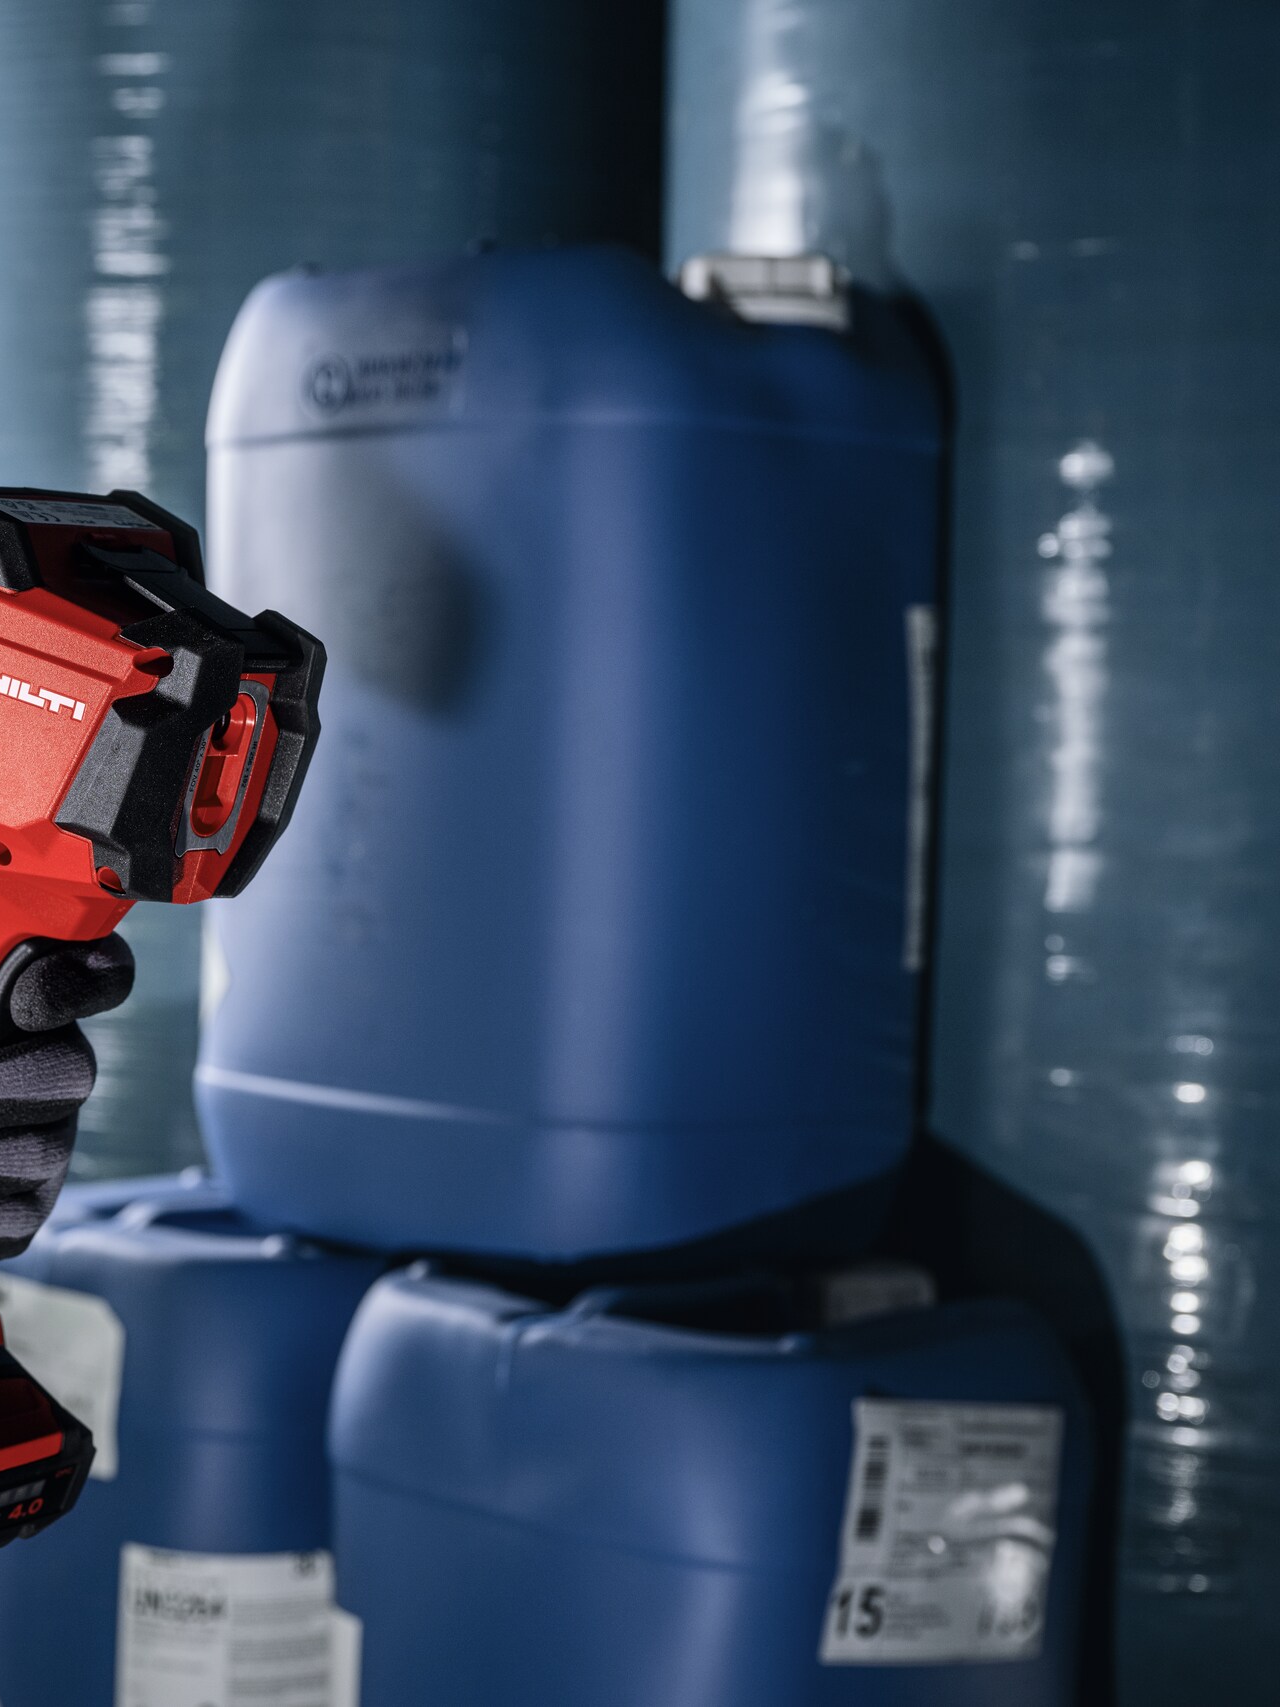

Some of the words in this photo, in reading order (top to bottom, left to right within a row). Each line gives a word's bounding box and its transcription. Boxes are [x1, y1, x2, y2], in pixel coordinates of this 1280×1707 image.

[189, 775, 198, 793] FOV
[7, 1498, 44, 1520] 4.0
[835, 1584, 886, 1639] 15
